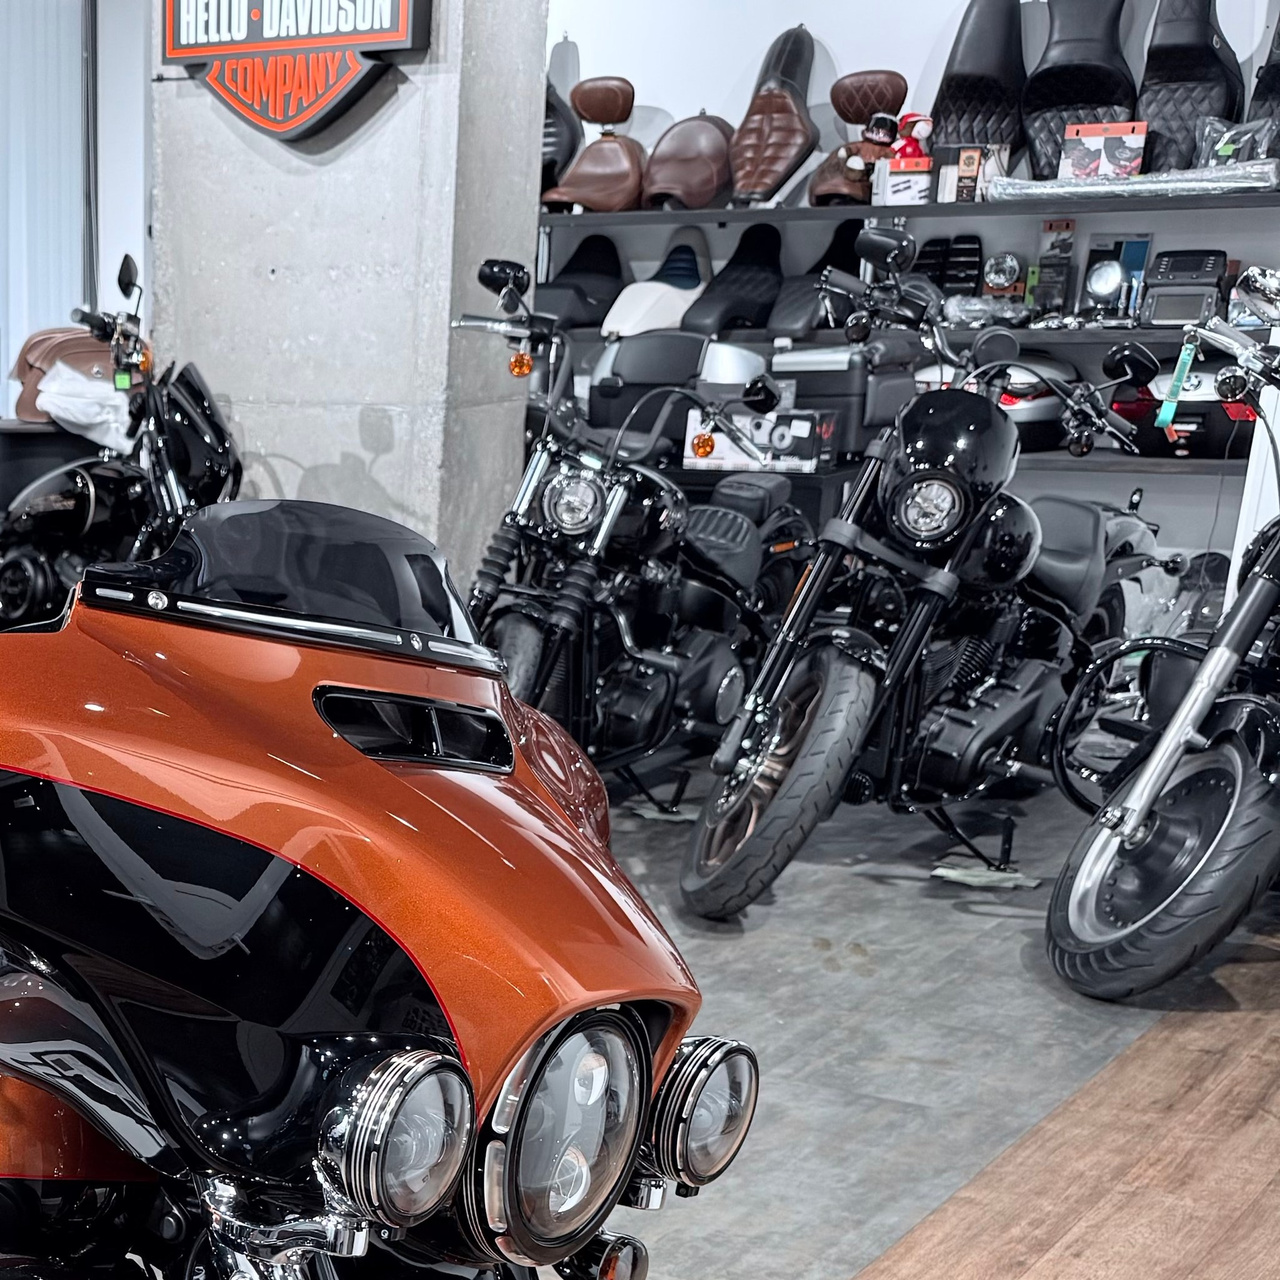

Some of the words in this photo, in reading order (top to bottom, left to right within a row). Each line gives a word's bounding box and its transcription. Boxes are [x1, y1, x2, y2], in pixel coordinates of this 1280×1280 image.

[180, 0, 248, 44] HELLO
[263, 0, 391, 38] DAVIDSON
[225, 51, 342, 120] COMPANY
